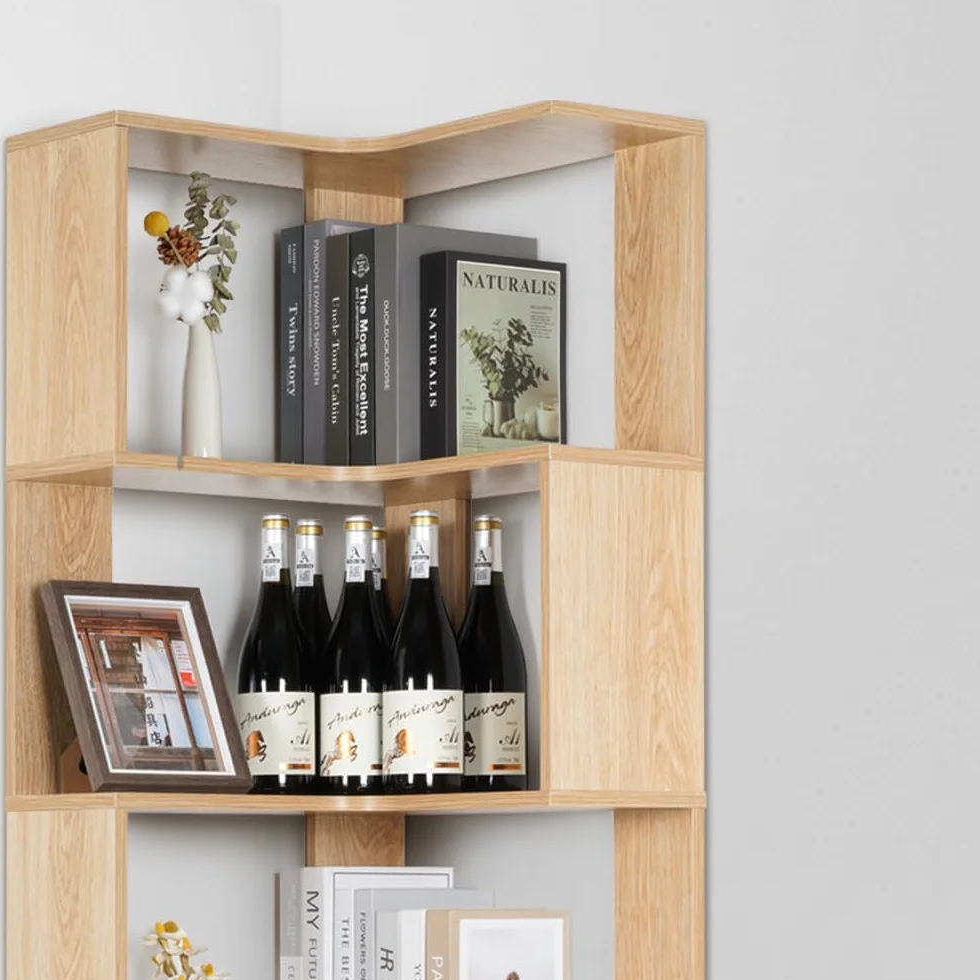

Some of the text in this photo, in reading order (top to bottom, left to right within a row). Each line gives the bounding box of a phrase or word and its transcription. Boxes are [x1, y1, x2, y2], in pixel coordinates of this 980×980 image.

[463, 271, 557, 297] NATURALIS
[286, 302, 298, 396] Twins story
[331, 296, 340, 424] Uncle Tom's Cabin
[359, 284, 368, 436] The Most Excellent
[428, 307, 437, 408] NATURALIS
[306, 890, 319, 930] MY
[341, 917, 350, 949] THE
[380, 947, 394, 972] HR
